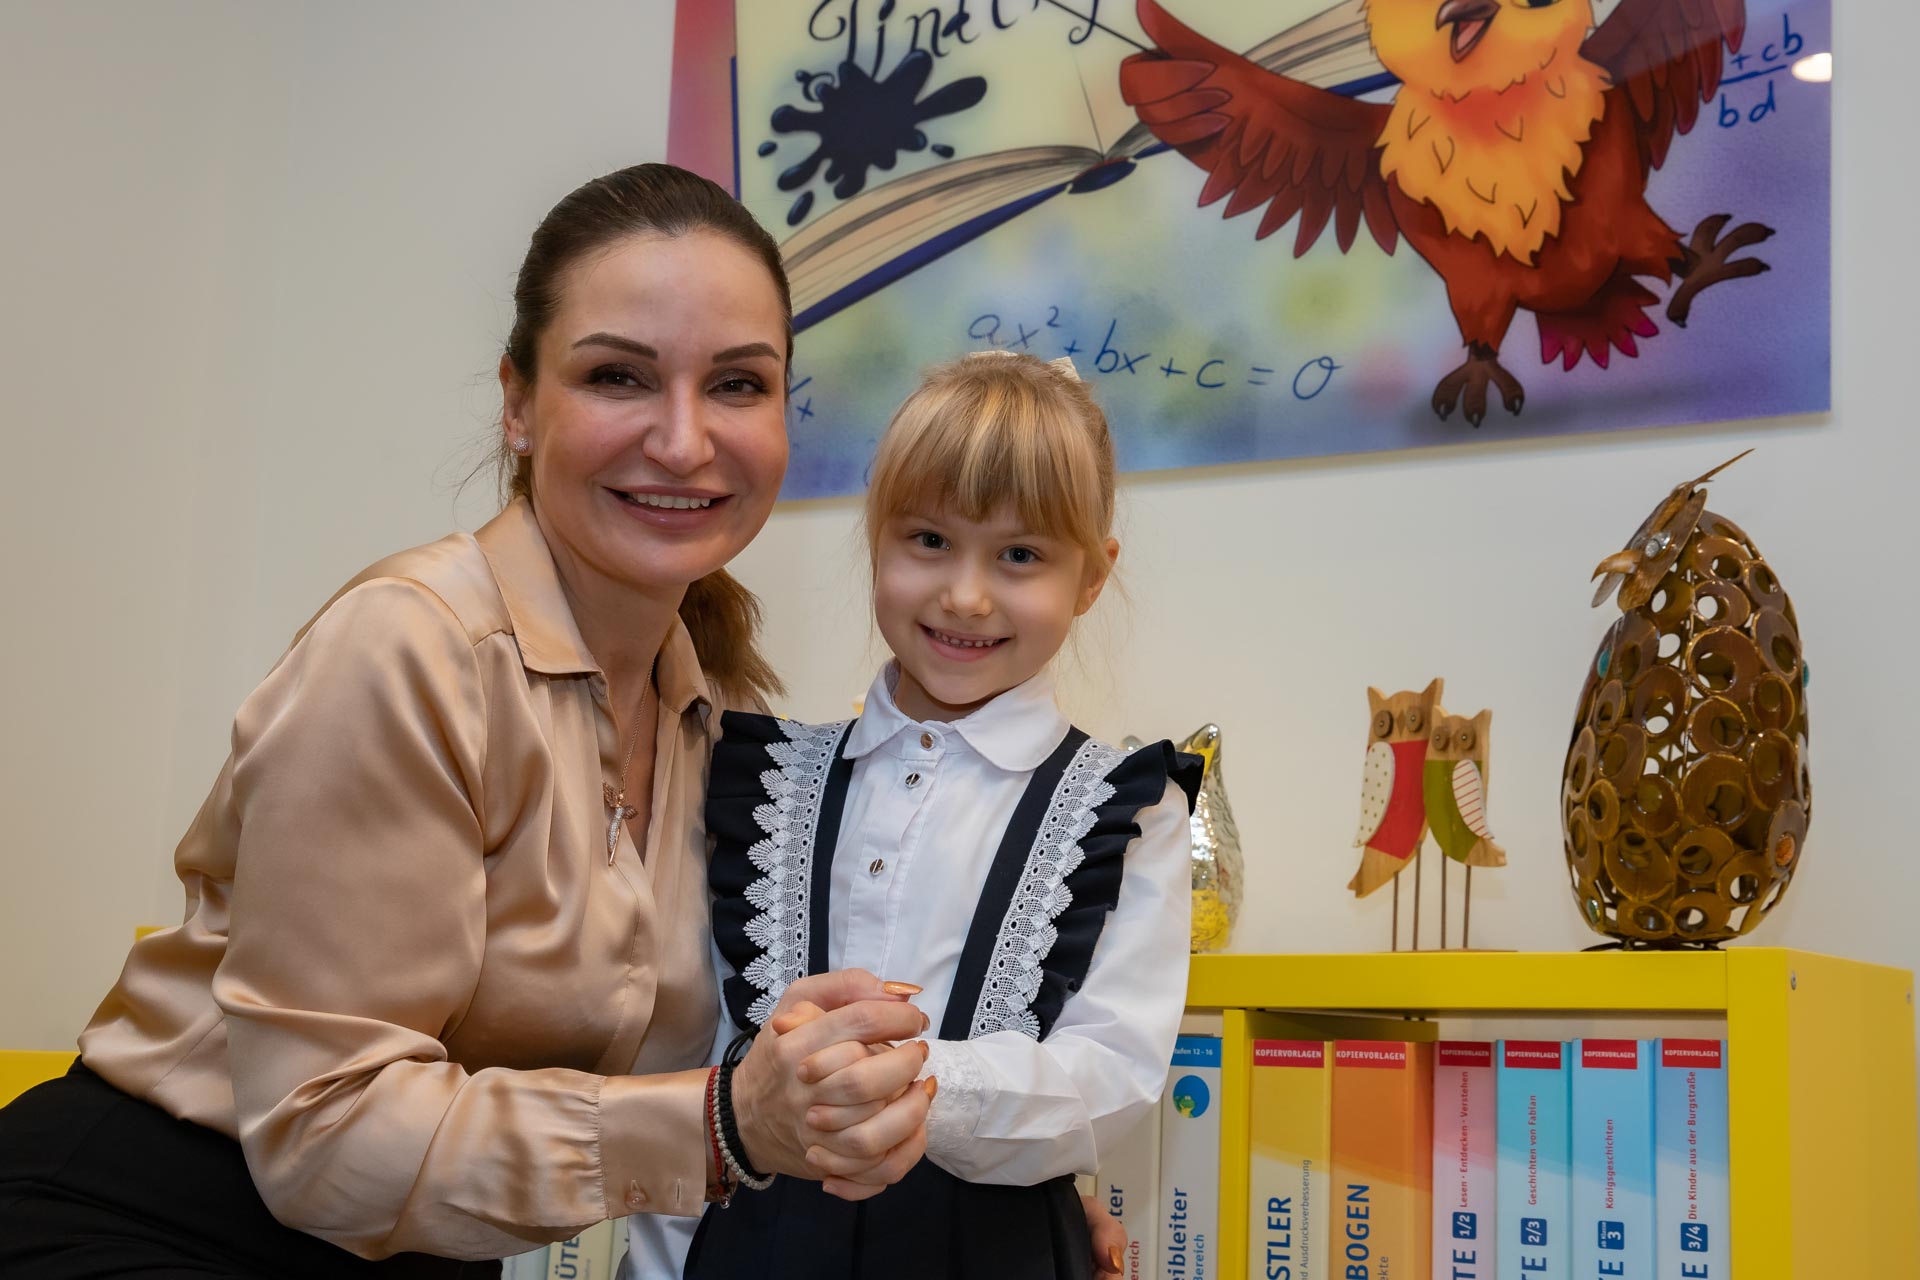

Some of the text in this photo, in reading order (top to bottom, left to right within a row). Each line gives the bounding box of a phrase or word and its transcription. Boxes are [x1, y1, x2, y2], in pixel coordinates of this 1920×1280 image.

[1095, 319, 1151, 373] bx
[1160, 357, 1187, 379] +
[1247, 366, 1275, 386] =
[1255, 1049, 1322, 1058] KOPIERVORLAGEN
[1336, 1050, 1406, 1060] KOPIERVORLAGEN
[1441, 1049, 1490, 1057] KOPIERVORLAGEN
[1506, 1051, 1559, 1059] KOPIERVORLAGEN
[1583, 1050, 1636, 1058] KOPIERVORLAGEN
[1664, 1049, 1719, 1057] KOPIERVORLAGEN
[1460, 1071, 1469, 1118] Verstehen
[1686, 1071, 1698, 1126] Burgstraße
[1527, 1095, 1537, 1126] Fabian
[1687, 1128, 1697, 1145] der
[1459, 1126, 1468, 1173] Entdecken
[1689, 1147, 1697, 1165] aus
[1604, 1119, 1616, 1209] Königsgeschichten
[1528, 1148, 1537, 1206] Geschichten
[1687, 1168, 1697, 1201] Kinder
[1459, 1181, 1468, 1208] Lesen
[1299, 1159, 1313, 1269] Ausdrucksverbesserung
[1688, 1203, 1698, 1220] Die
[1345, 1184, 1370, 1280] BOGEN
[1456, 1214, 1472, 1237] 1/2
[1525, 1220, 1542, 1244] 2/3
[1607, 1231, 1622, 1241] 3
[1685, 1225, 1703, 1250] 3/4
[1266, 1197, 1292, 1280] STLER
